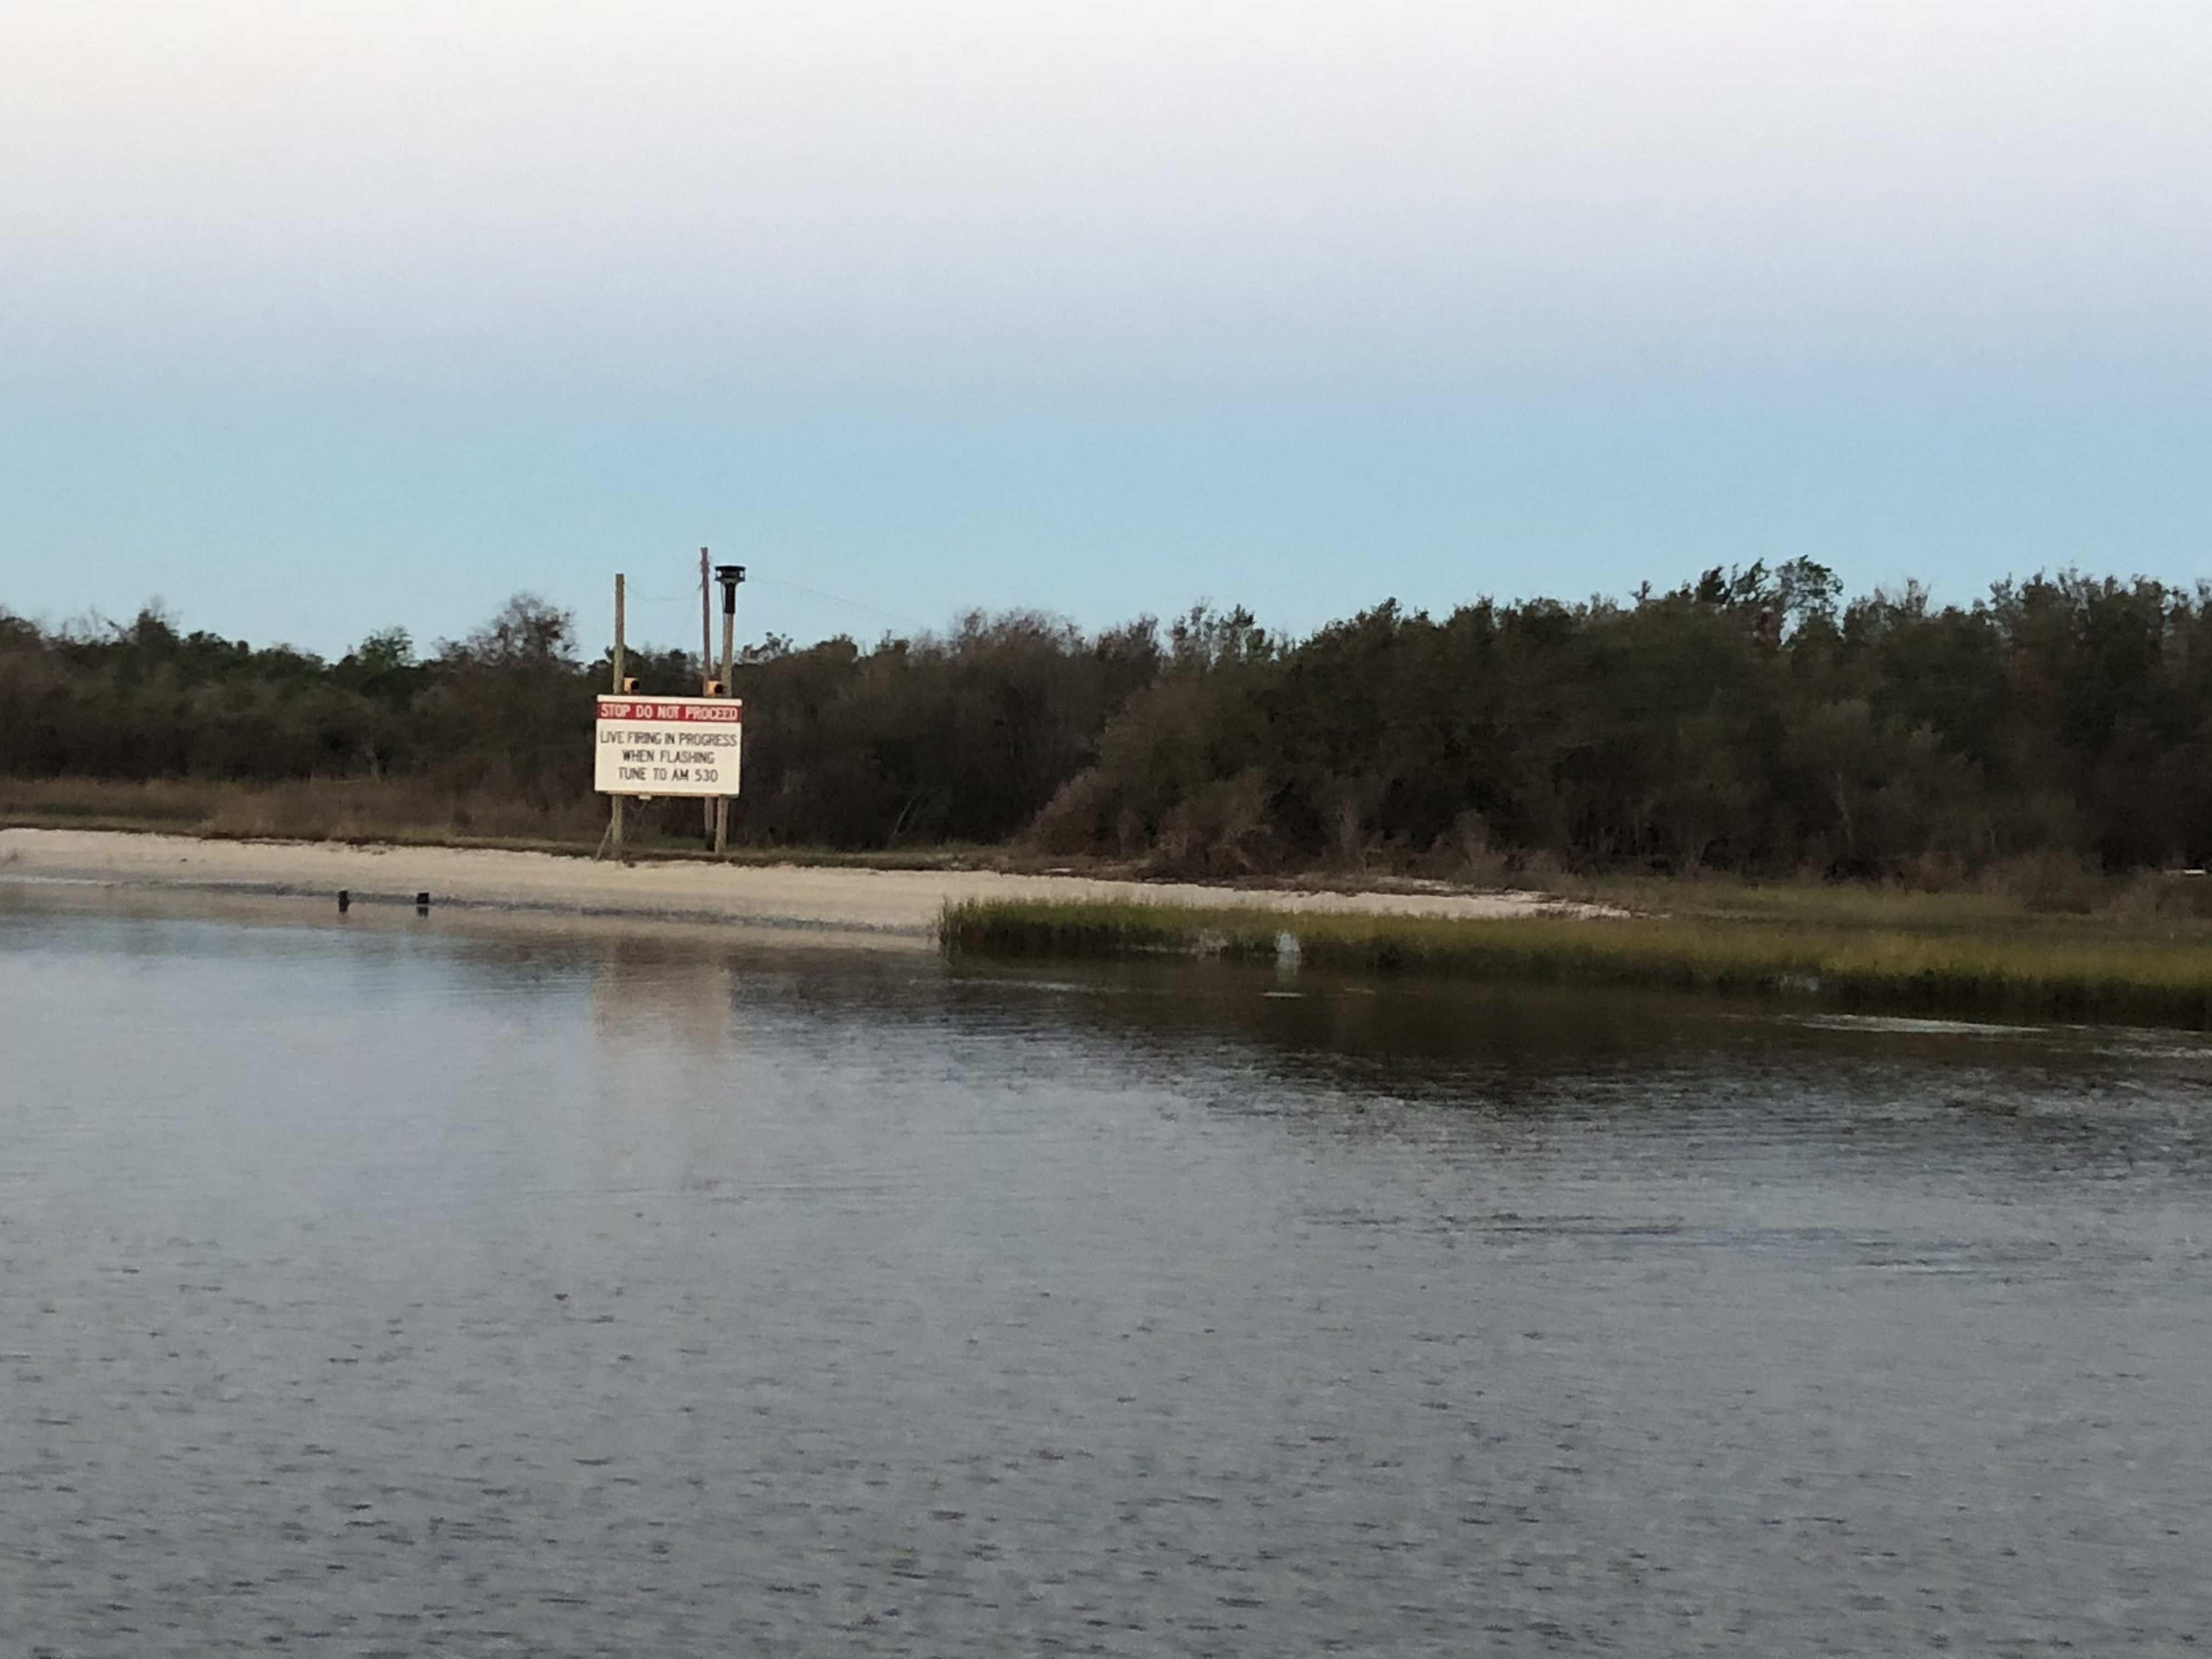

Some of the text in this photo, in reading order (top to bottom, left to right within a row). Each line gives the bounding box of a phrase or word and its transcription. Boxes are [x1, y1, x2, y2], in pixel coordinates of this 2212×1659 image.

[601, 704, 737, 720] STOP DO NOT PROCEED
[600, 730, 737, 747] LIVE FIRING IN PROGRESS
[622, 749, 715, 764] WHEN FLASHING
[618, 767, 719, 782] TUNE TO AM 530
